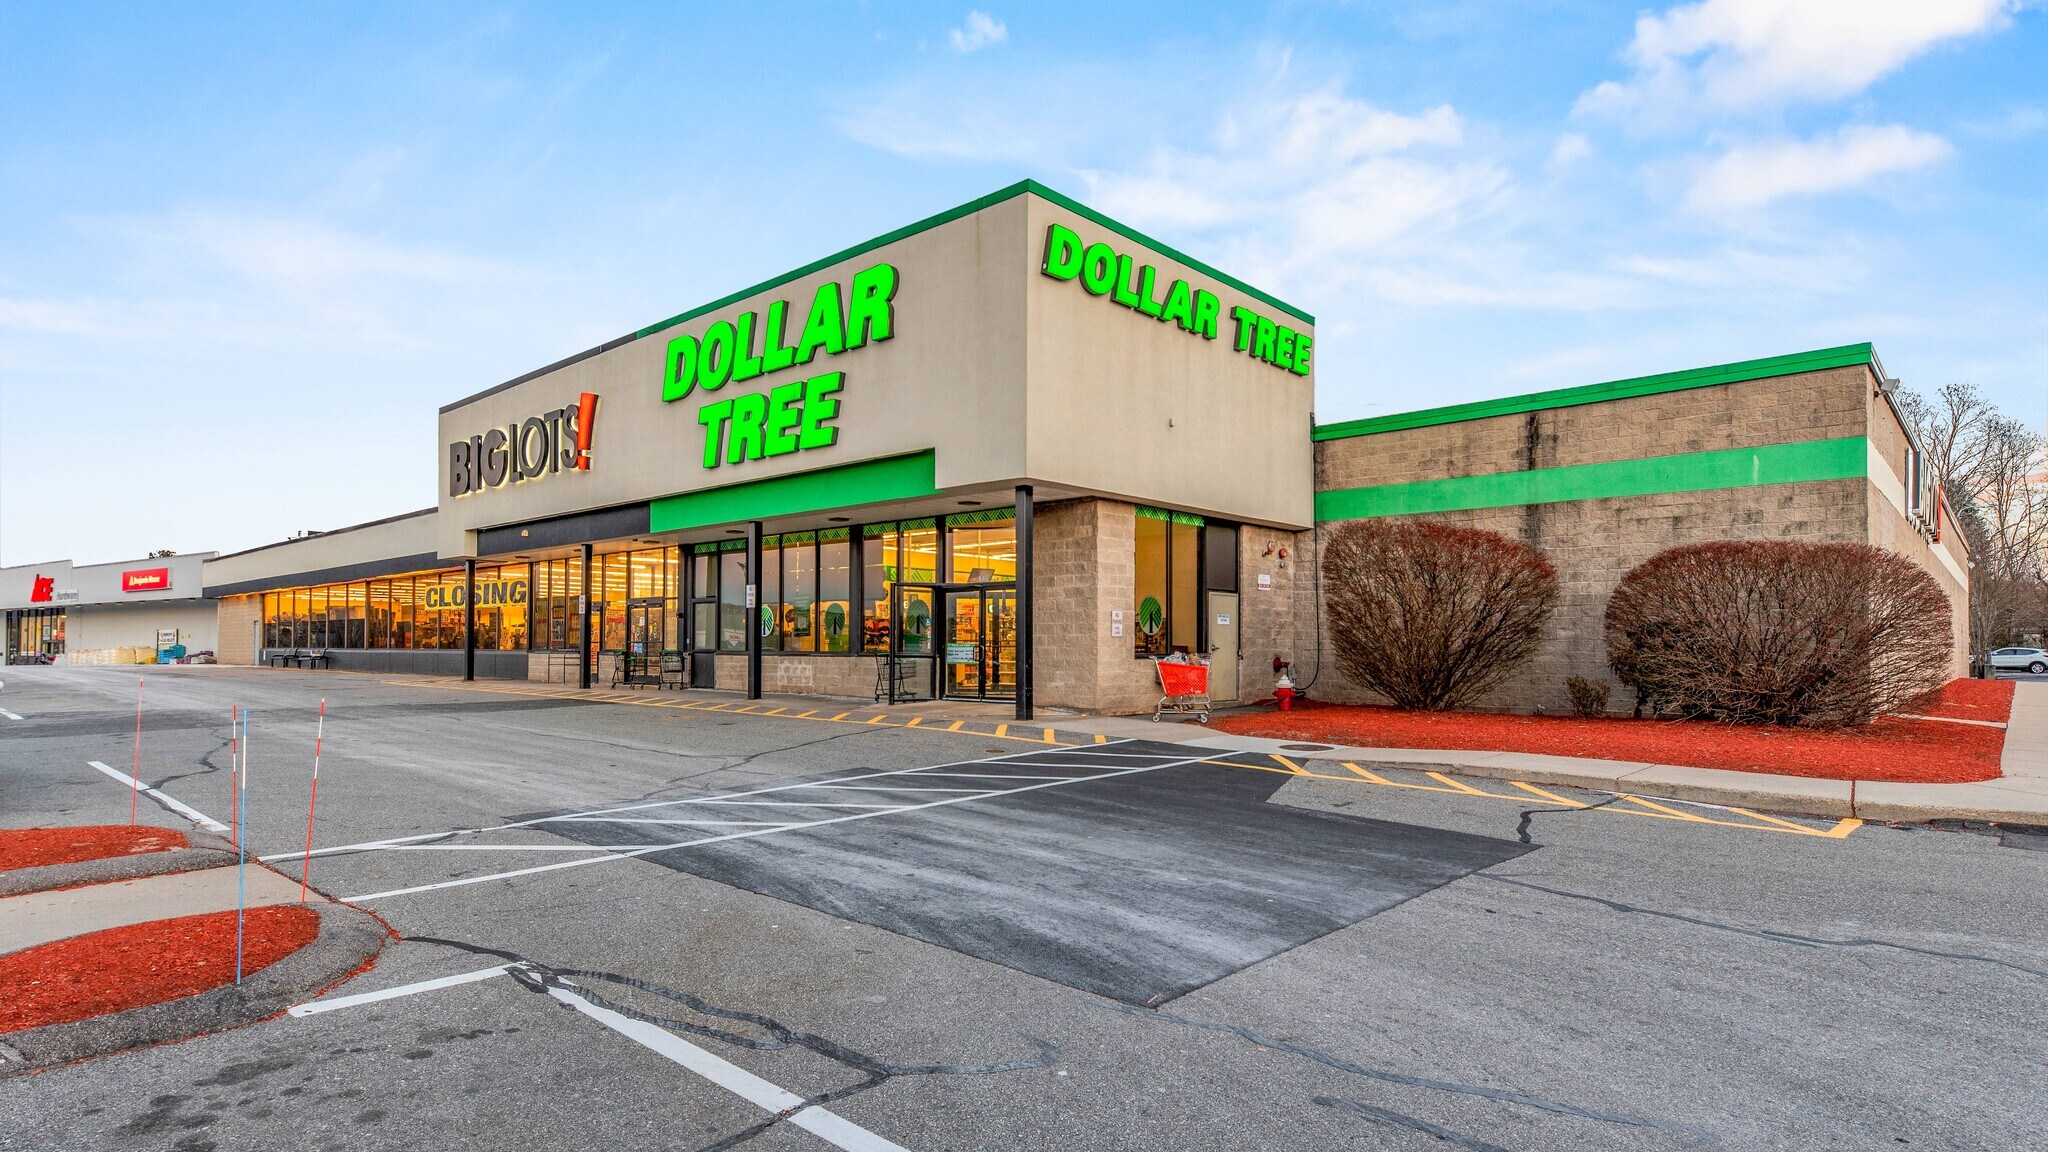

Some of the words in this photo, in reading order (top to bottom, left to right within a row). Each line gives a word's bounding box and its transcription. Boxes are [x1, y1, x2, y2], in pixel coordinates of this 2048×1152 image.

[662, 263, 898, 402] DOLLAR
[1042, 223, 1220, 340] DOLLAR
[1230, 306, 1313, 376] TREE
[450, 428, 508, 497] BIG
[509, 393, 599, 482] LOTS!
[698, 371, 846, 468] TREE
[425, 580, 527, 608] CLOSING
